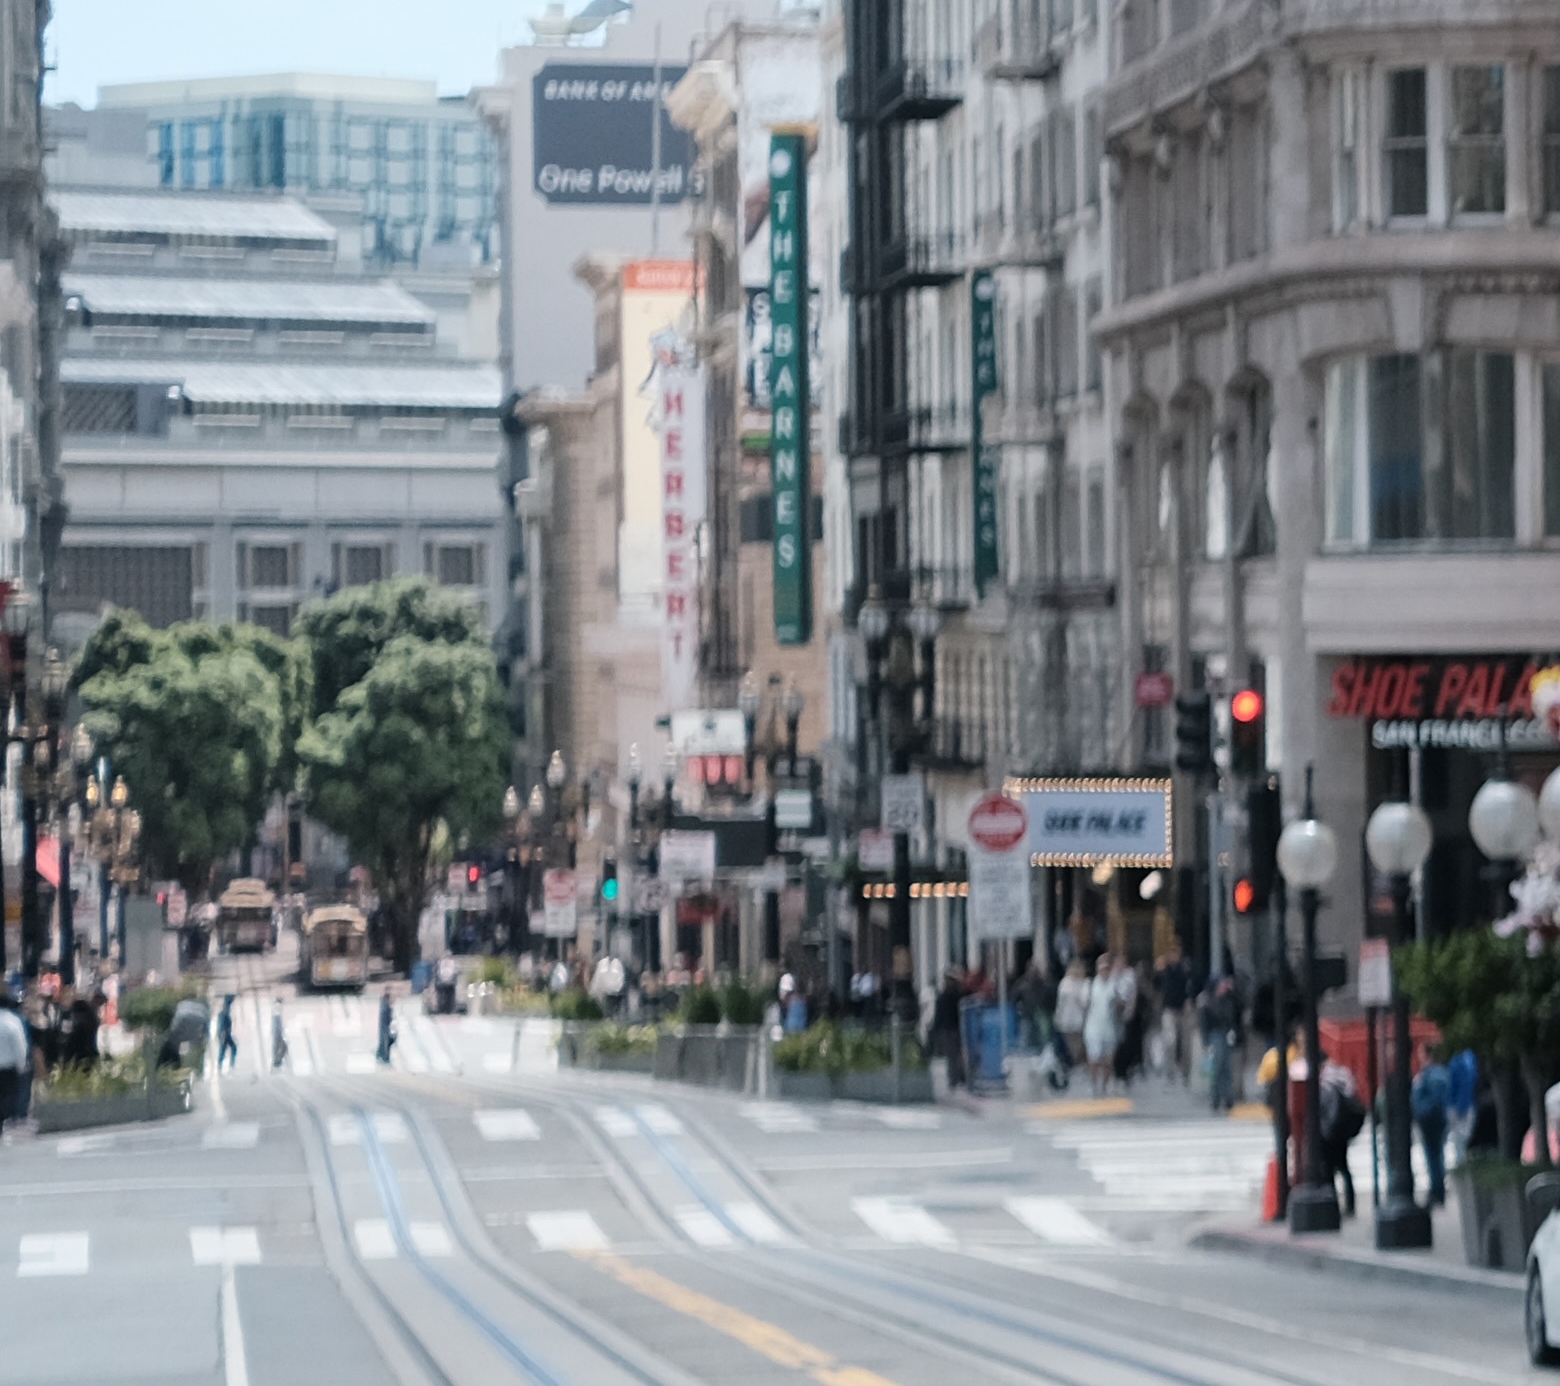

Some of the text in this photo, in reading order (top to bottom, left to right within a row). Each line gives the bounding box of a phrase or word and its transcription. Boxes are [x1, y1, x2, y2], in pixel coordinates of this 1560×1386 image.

[544, 79, 598, 101] BANK
[539, 164, 593, 193] One
[772, 190, 796, 568] THE BARNES
[1326, 663, 1538, 718] SHOE PALA
